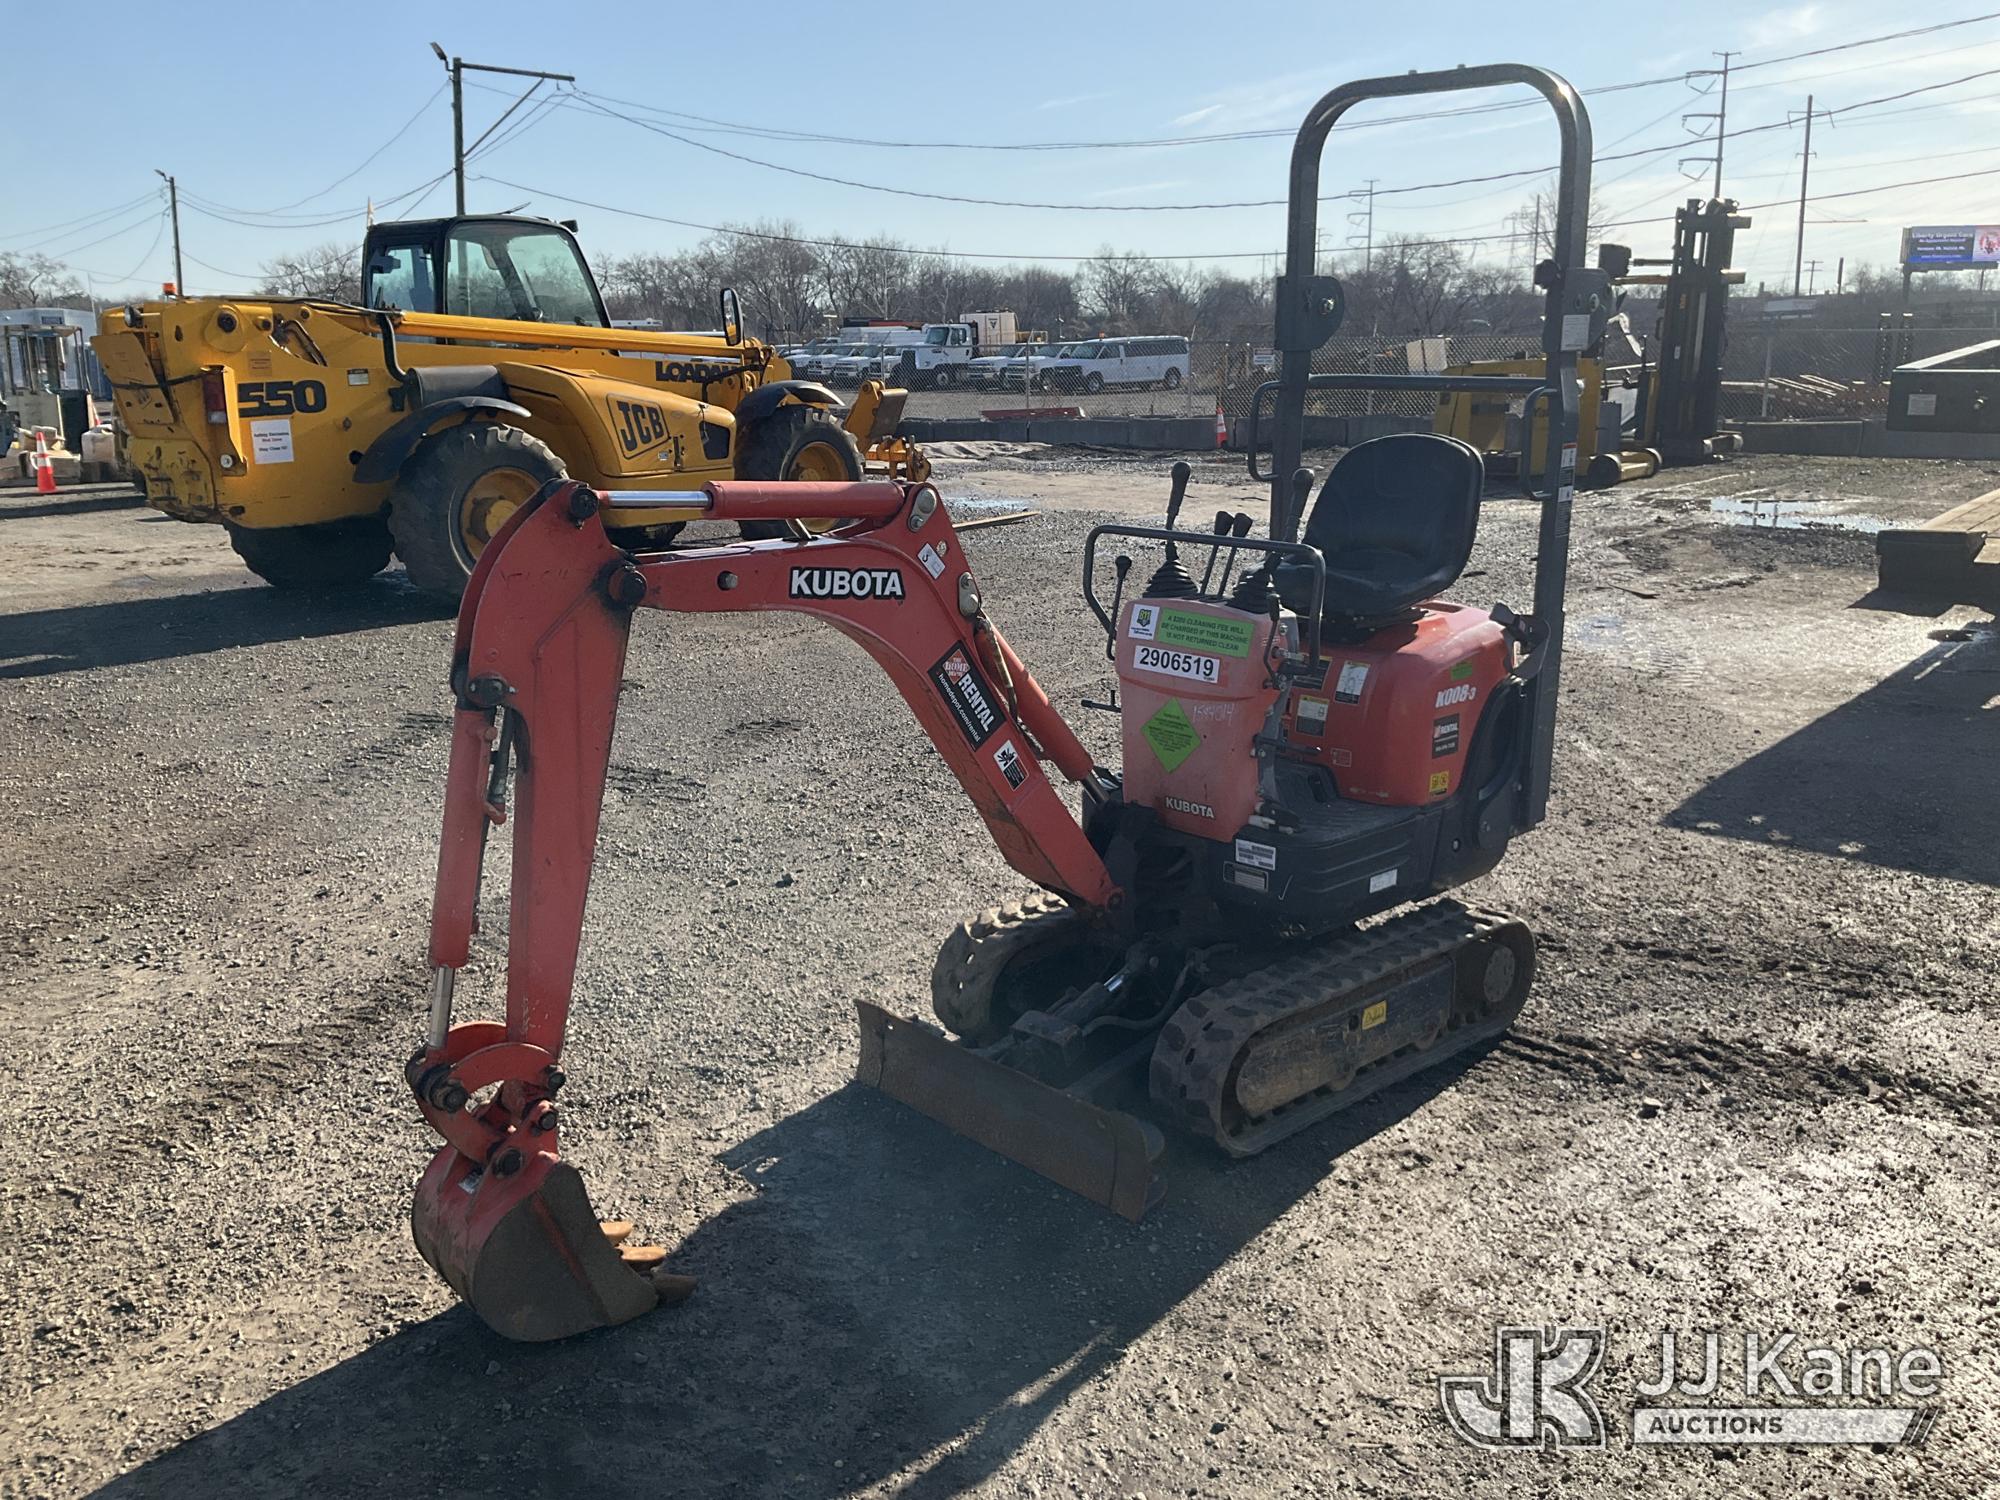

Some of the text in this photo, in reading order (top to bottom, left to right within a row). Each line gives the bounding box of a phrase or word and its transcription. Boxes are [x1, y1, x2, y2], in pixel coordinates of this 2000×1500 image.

[237, 380, 327, 418] 550
[616, 400, 665, 451] JCB
[790, 567, 904, 598] KUBOTA
[1170, 623, 1198, 634] CHARGED
[1139, 648, 1214, 677] 2906519
[938, 672, 981, 743] homedepot.com/rental
[957, 672, 995, 732] RENTAL
[1435, 684, 1477, 708] K008-3
[1165, 797, 1215, 819] KUBOTA
